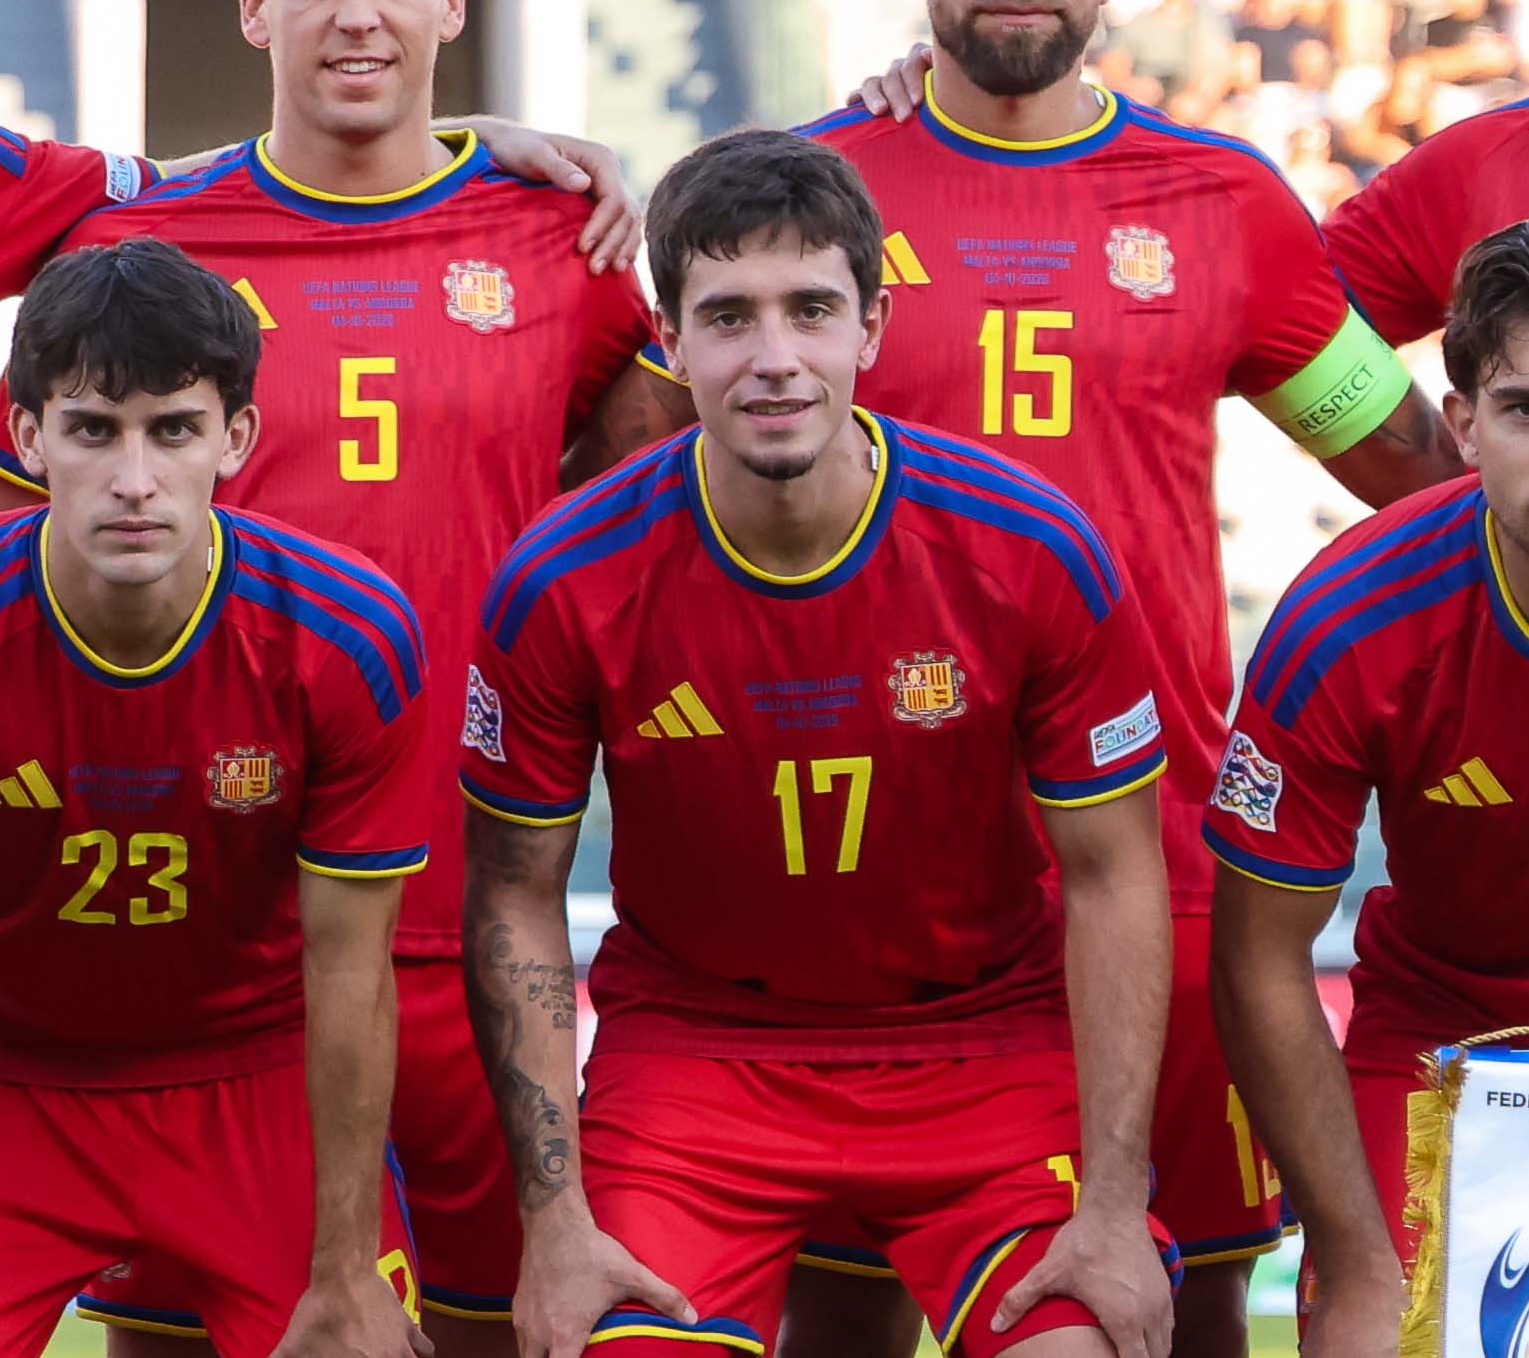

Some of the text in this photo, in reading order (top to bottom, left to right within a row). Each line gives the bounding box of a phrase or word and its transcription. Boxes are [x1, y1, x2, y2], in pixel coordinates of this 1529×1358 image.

[339, 357, 399, 482] 5
[978, 309, 1075, 438] 15
[1298, 363, 1374, 433] RESPECT
[774, 756, 873, 875] 17
[58, 830, 188, 925] 23
